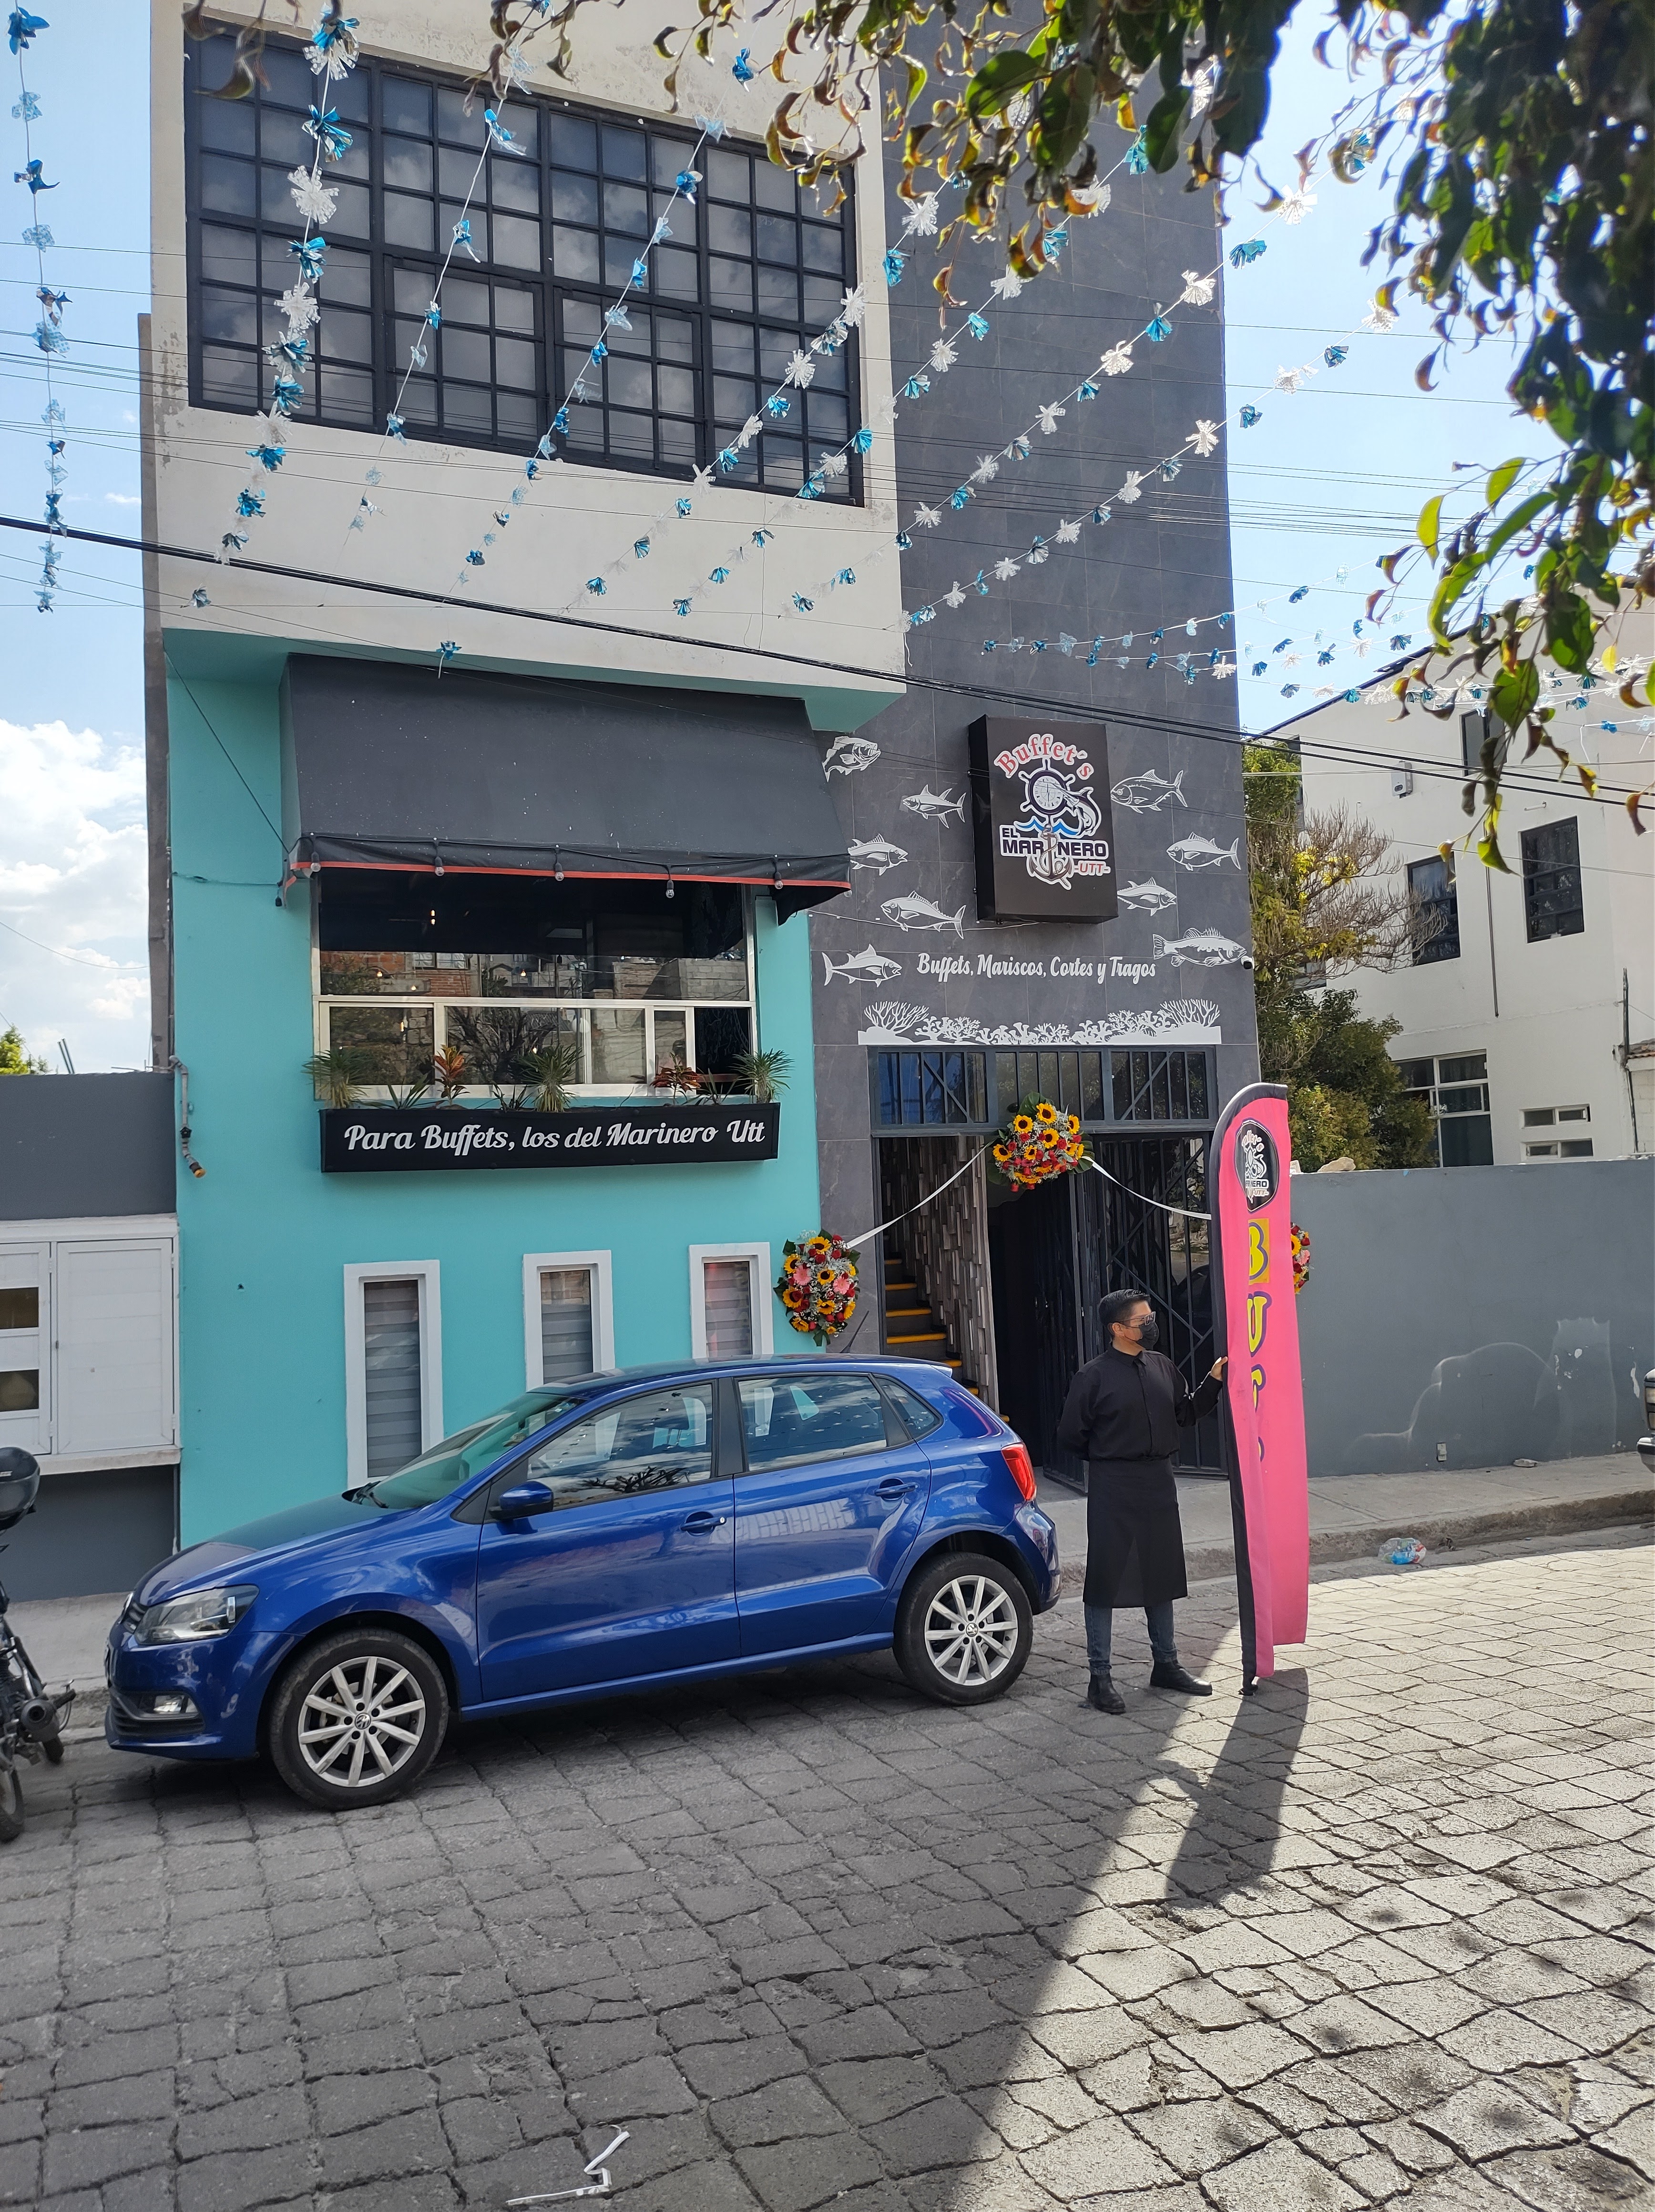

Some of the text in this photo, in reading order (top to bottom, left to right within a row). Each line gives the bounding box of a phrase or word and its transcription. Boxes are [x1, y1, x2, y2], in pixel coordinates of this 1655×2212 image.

[996, 736, 1093, 778] Buffet's
[1002, 827, 1018, 839] EL
[916, 952, 1156, 985] Buffets, Mariscos, Cortes y Tragos
[344, 1117, 766, 1156] Para Buffets, los del Marinero Utt
